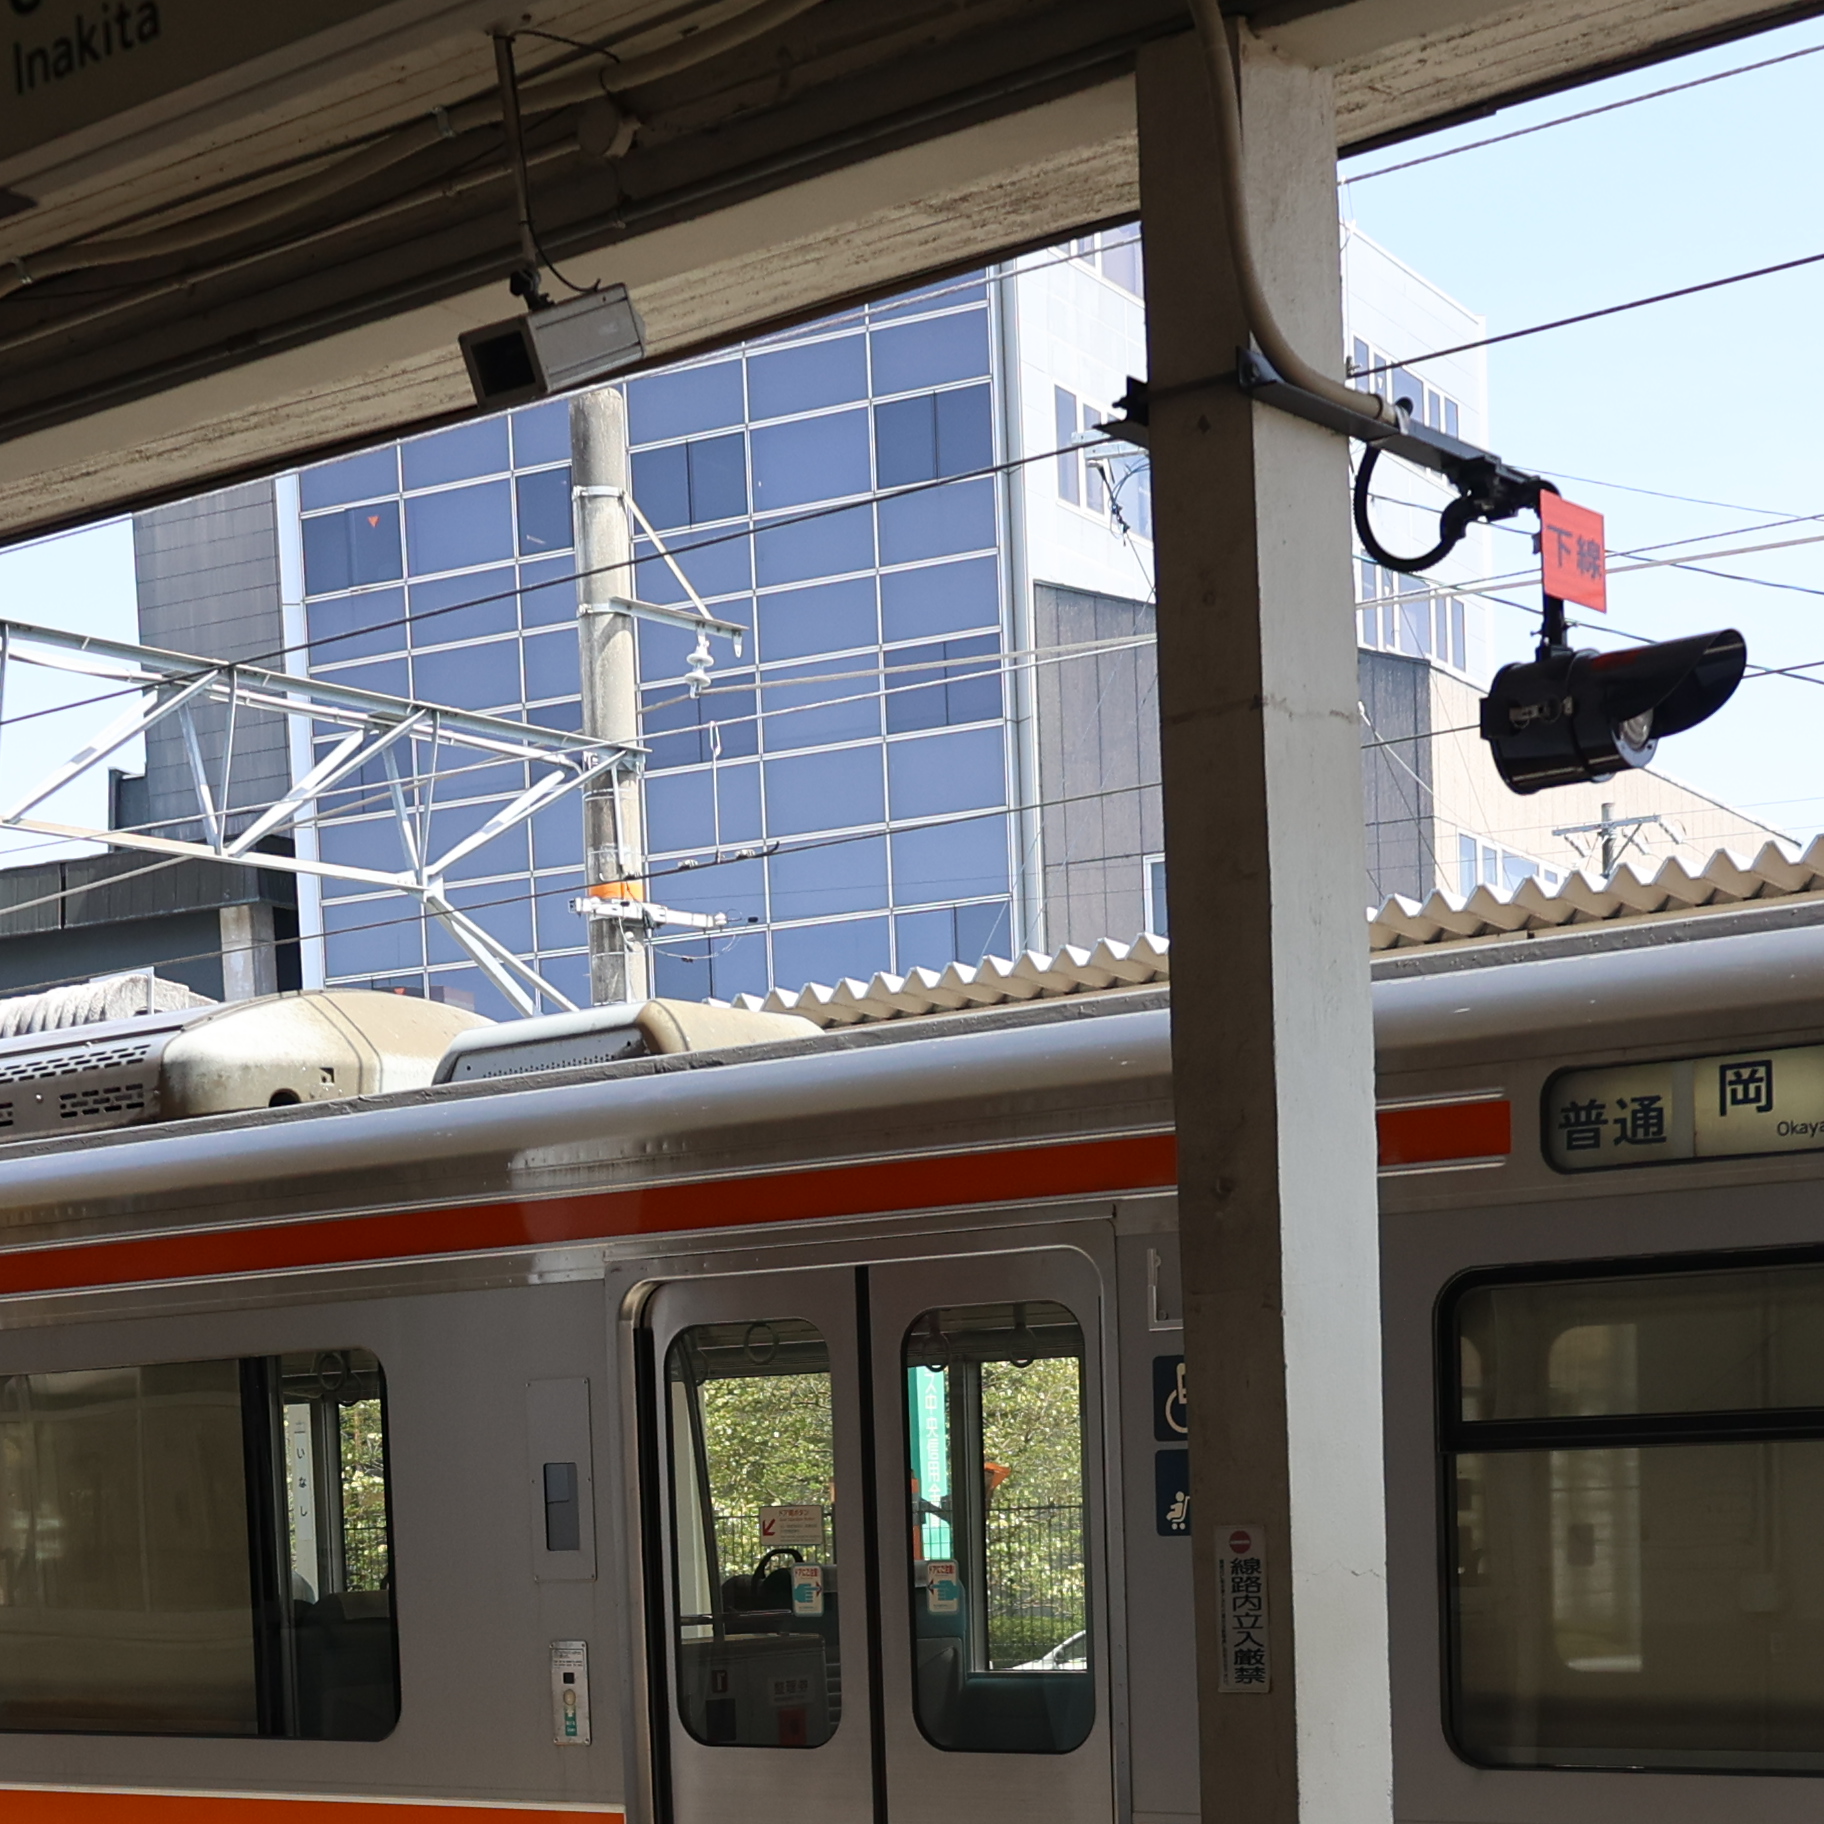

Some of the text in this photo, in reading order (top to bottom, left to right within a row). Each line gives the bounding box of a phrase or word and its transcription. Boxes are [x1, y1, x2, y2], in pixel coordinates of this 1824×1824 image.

[13, 1, 160, 94] Inakita
[1547, 525, 1601, 580] 下線
[1558, 1095, 1667, 1150] 普通
[1230, 1558, 1265, 1684] 線路内立入厳禁
